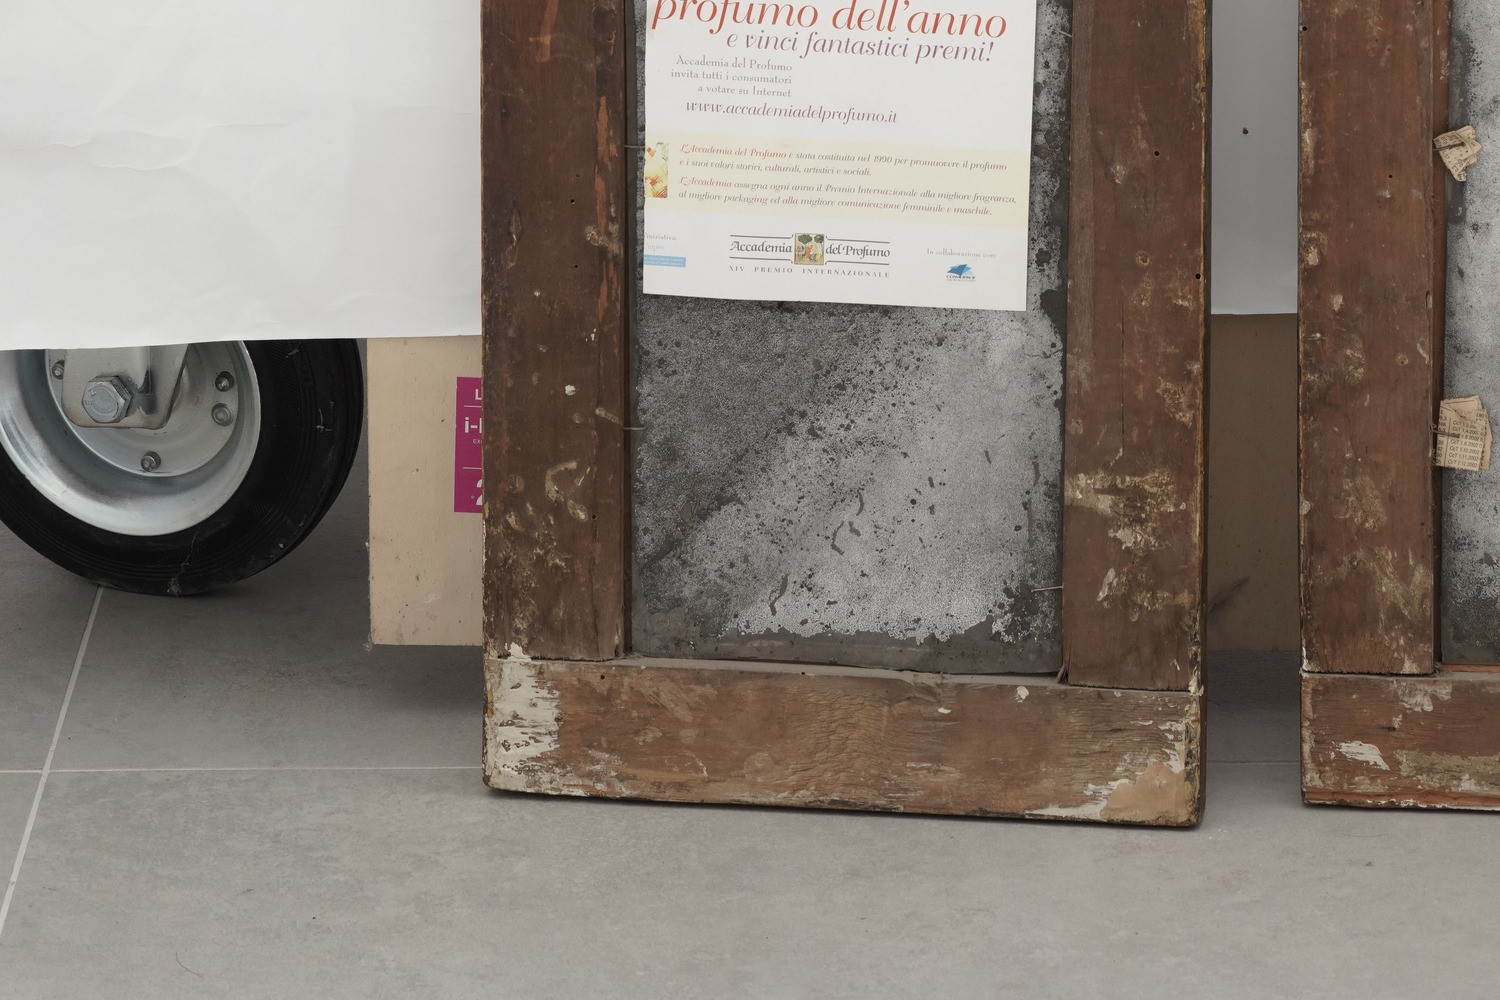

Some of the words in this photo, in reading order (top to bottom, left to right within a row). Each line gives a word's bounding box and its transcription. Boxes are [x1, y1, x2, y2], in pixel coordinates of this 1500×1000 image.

[726, 33, 738, 47] e
[745, 29, 799, 51] vinci
[799, 31, 910, 59] fantastici
[915, 41, 995, 64] premi!
[676, 55, 729, 67] Accademia
[731, 57, 746, 68] del
[750, 59, 793, 71] Profumo
[671, 69, 699, 79] invita
[702, 71, 723, 80] tutti
[725, 72, 729, 81] i
[732, 74, 792, 84] consumatori
[706, 85, 735, 94] votare
[738, 87, 749, 95] su
[752, 86, 792, 97] Internet
[686, 101, 897, 125] www.accademiadelprofumo.it
[691, 159, 708, 167] suoi
[710, 160, 734, 169] valori
[804, 166, 835, 174] artistici
[734, 148, 748, 156] del
[750, 150, 787, 159] Profumo
[795, 152, 816, 160] stata
[817, 153, 855, 162] costituita
[857, 154, 870, 162] nel
[873, 155, 893, 163] 1990
[894, 157, 909, 166] per
[909, 159, 961, 168] promuovere
[962, 160, 968, 168] il
[969, 161, 1007, 171] profumo
[734, 182, 768, 191] assegna
[770, 181, 790, 192] ogni
[816, 183, 822, 191] il
[825, 183, 855, 193] Premio
[857, 185, 918, 197] Internazionale
[920, 190, 936, 198] alla
[938, 191, 971, 202] migliore
[689, 191, 722, 202] migliore
[724, 193, 768, 206] packaging
[770, 196, 781, 204] ed
[782, 196, 798, 204] alla
[800, 197, 835, 208] migliore
[837, 199, 901, 210] comunicazione
[902, 202, 945, 213] femminile
[729, 240, 792, 253] Accademia
[825, 243, 841, 254] del
[842, 244, 891, 260] Profumo
[936, 248, 981, 258] collaborazione
[802, 268, 890, 278] INTERNAZIONALE
